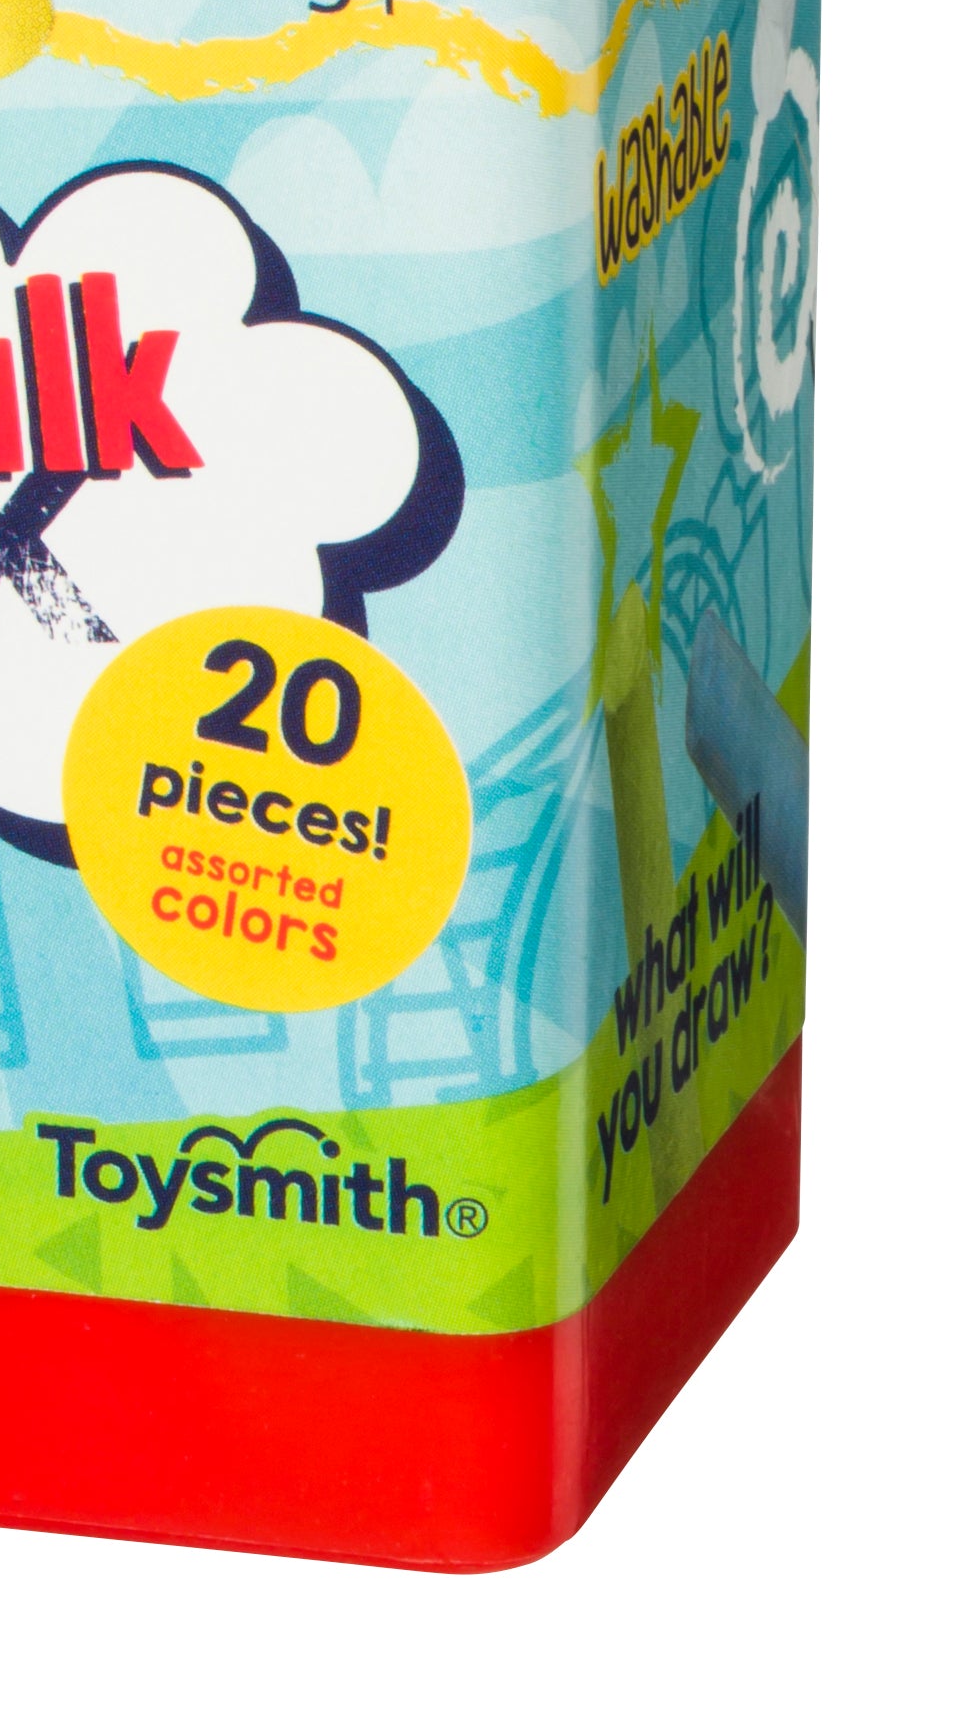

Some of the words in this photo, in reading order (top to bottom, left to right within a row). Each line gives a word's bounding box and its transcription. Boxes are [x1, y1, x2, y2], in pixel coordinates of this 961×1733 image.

[596, 43, 730, 274] washable
[195, 639, 361, 766] 20
[138, 760, 391, 861] pieces!
[150, 885, 340, 962] colors
[160, 844, 345, 909] assorted
[613, 872, 699, 1057] what
[707, 791, 761, 942] will
[596, 1047, 663, 1205] you
[671, 882, 774, 1094] draw?
